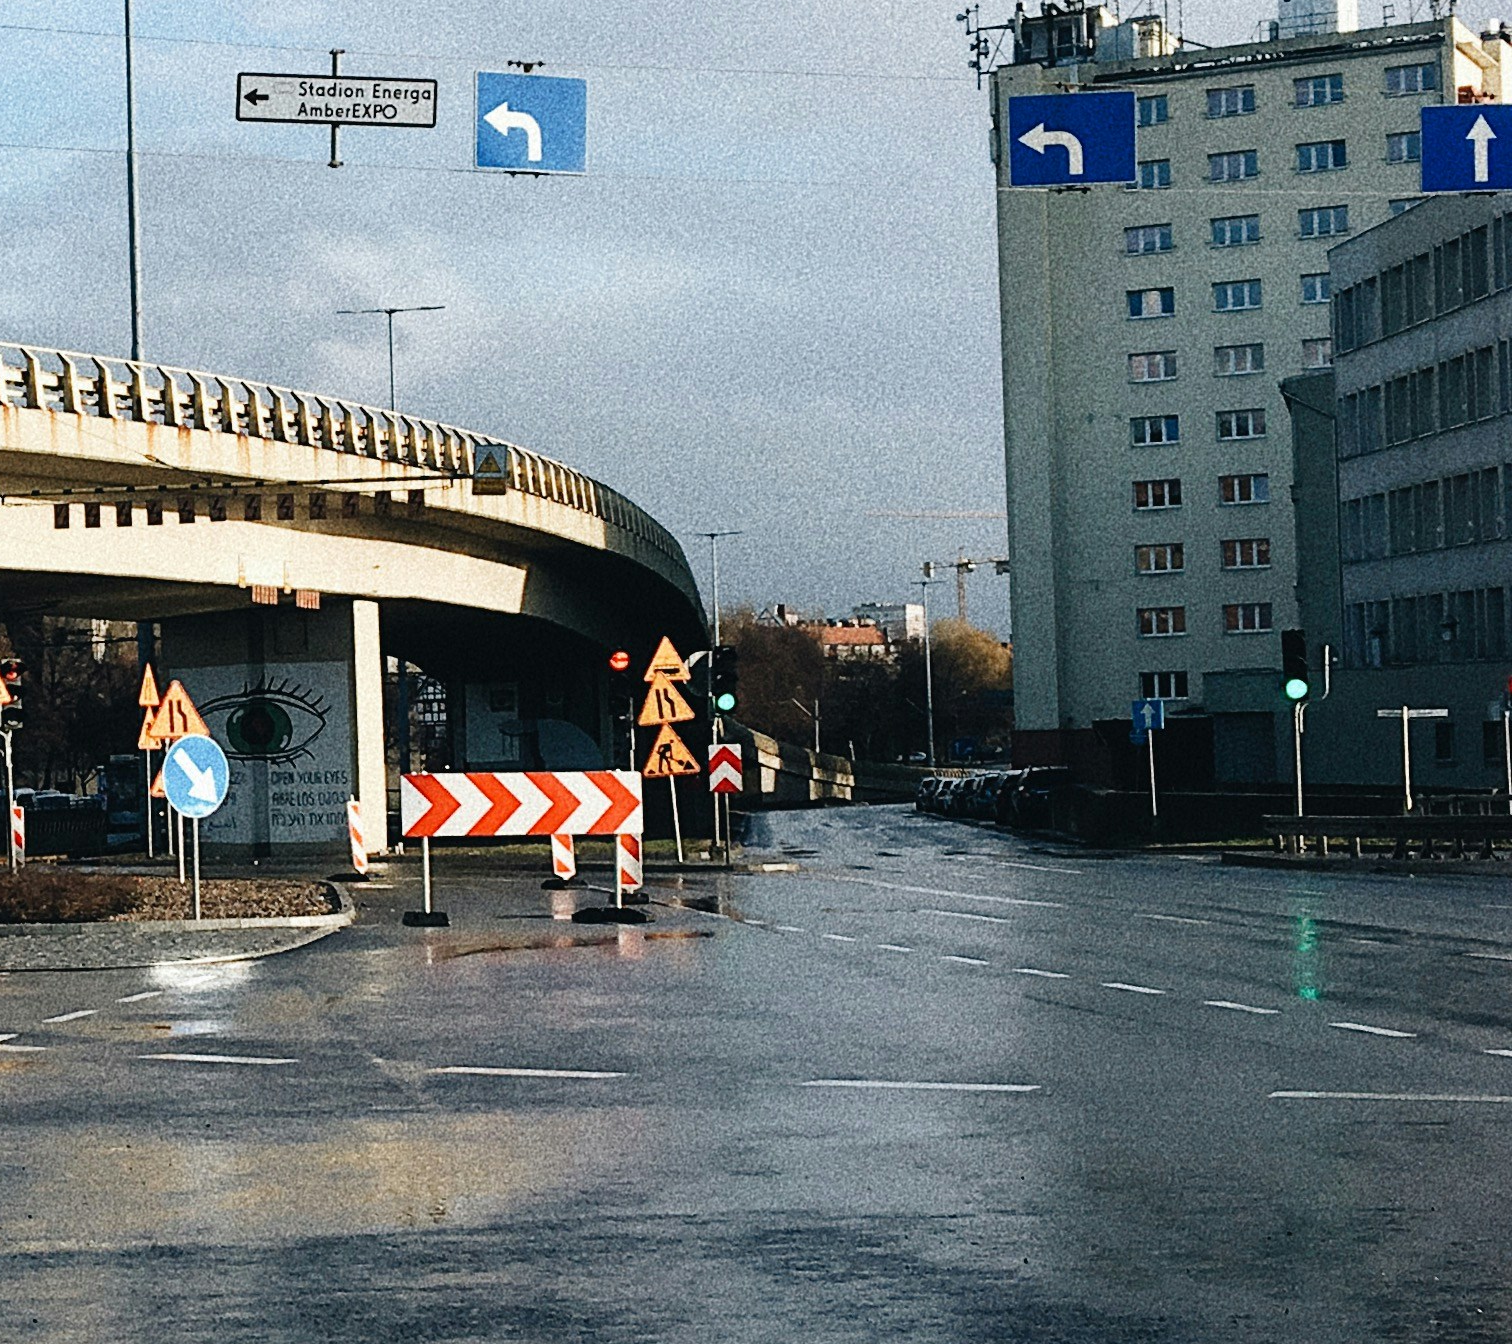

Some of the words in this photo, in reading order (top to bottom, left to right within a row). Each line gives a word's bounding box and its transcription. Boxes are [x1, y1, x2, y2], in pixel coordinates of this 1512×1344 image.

[298, 81, 364, 98] Stadion
[372, 83, 431, 104] Energa
[297, 101, 397, 119] AmberEXPO
[270, 771, 295, 785] OPEN
[297, 771, 322, 785] YOUR
[324, 770, 348, 785] EYES
[297, 791, 315, 806] LOS
